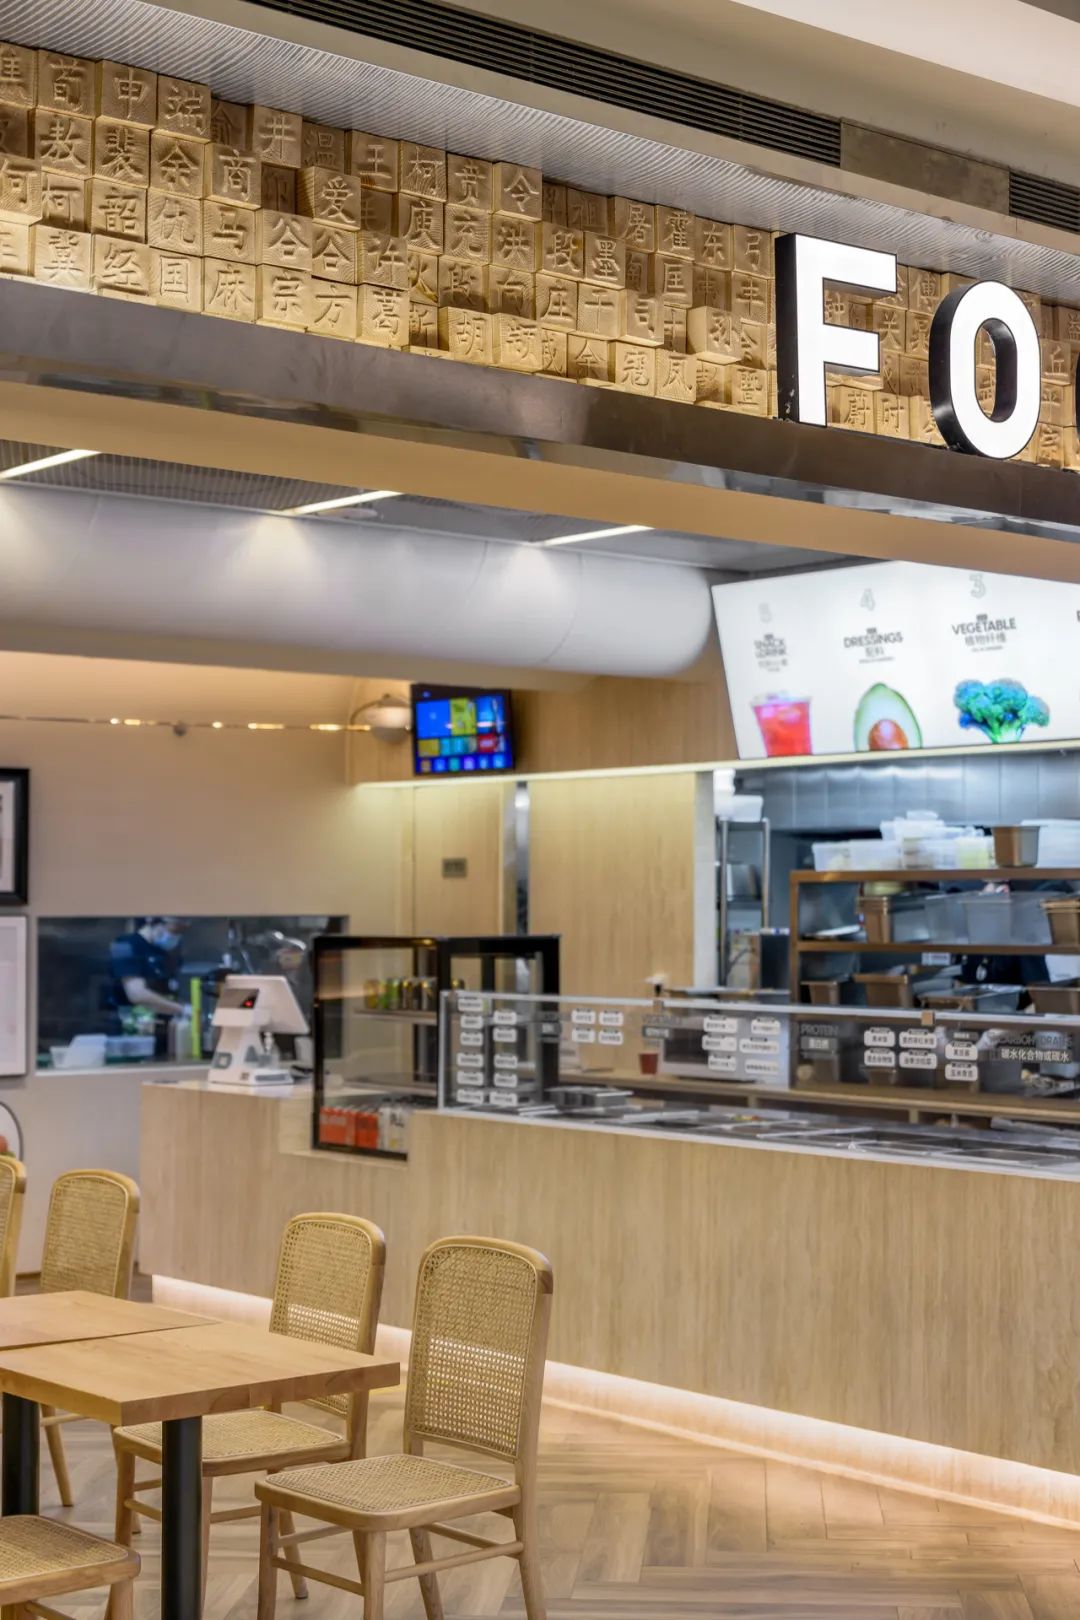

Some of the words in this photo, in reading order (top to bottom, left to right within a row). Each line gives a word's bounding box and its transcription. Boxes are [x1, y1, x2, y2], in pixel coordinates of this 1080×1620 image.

[775, 232, 1080, 460] FO
[968, 573, 986, 599] 3
[860, 588, 876, 611] 4
[951, 617, 1017, 636] VEGETABLE
[843, 631, 904, 648] DRESSINGS
[800, 1023, 839, 1037] PROTEIN
